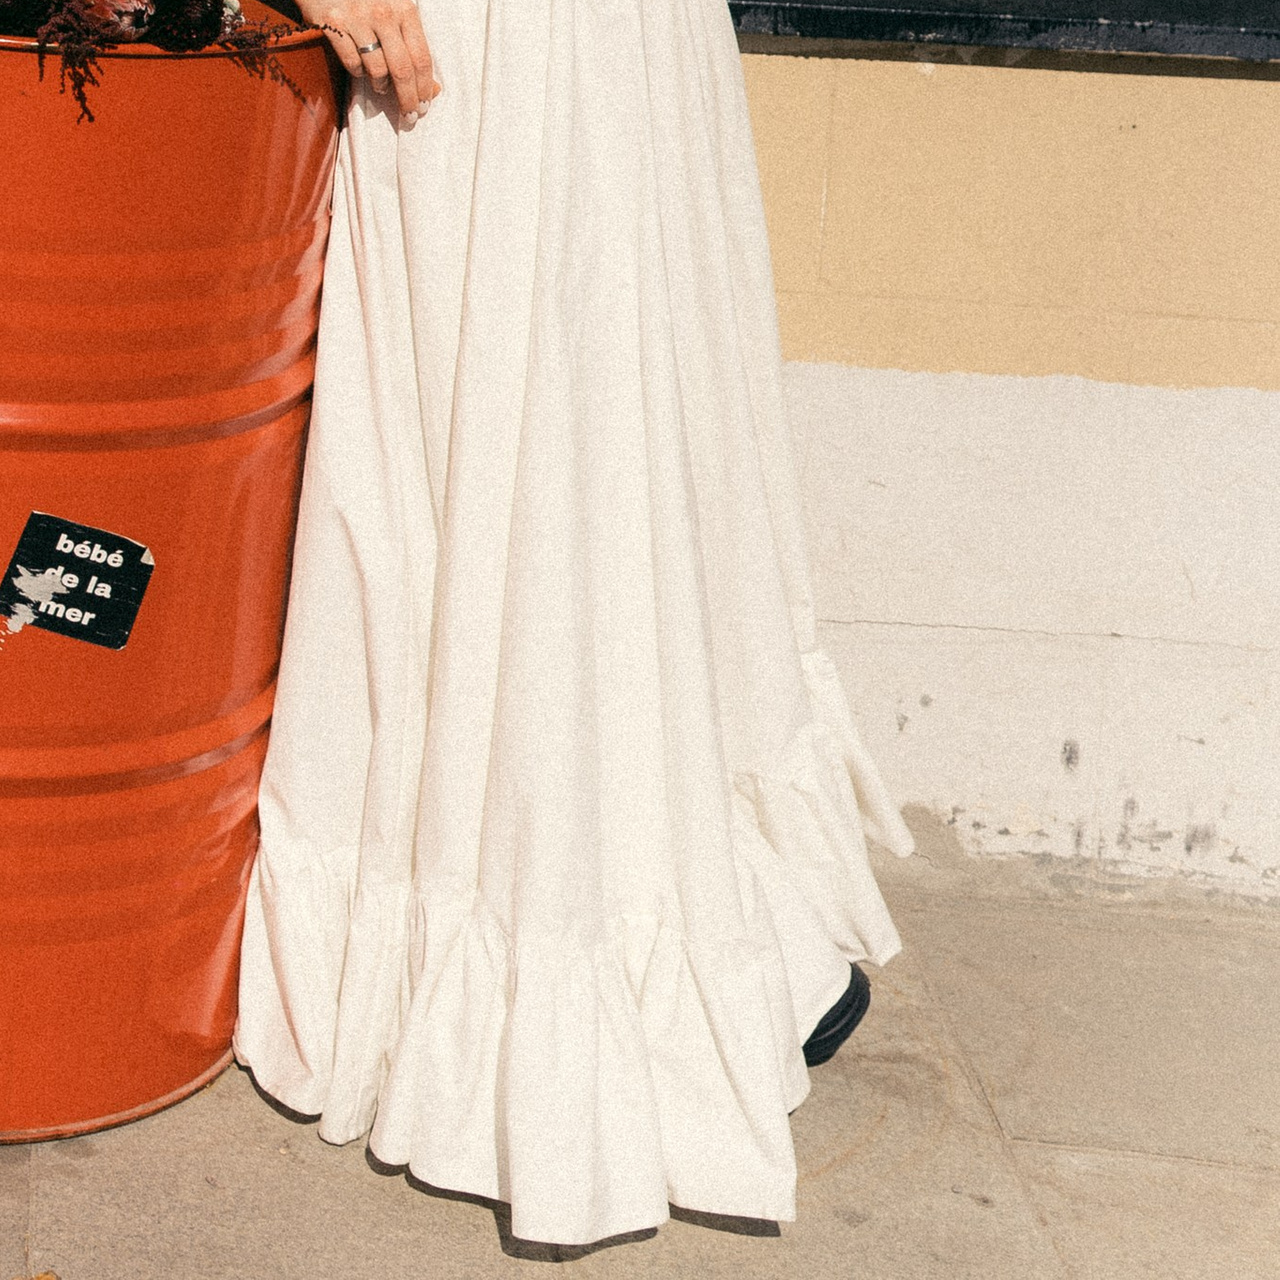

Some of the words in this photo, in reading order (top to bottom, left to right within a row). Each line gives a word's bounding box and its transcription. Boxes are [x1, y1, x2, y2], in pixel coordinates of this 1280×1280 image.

[55, 533, 124, 567] bébé
[86, 575, 112, 599] la
[38, 600, 96, 626] mer
